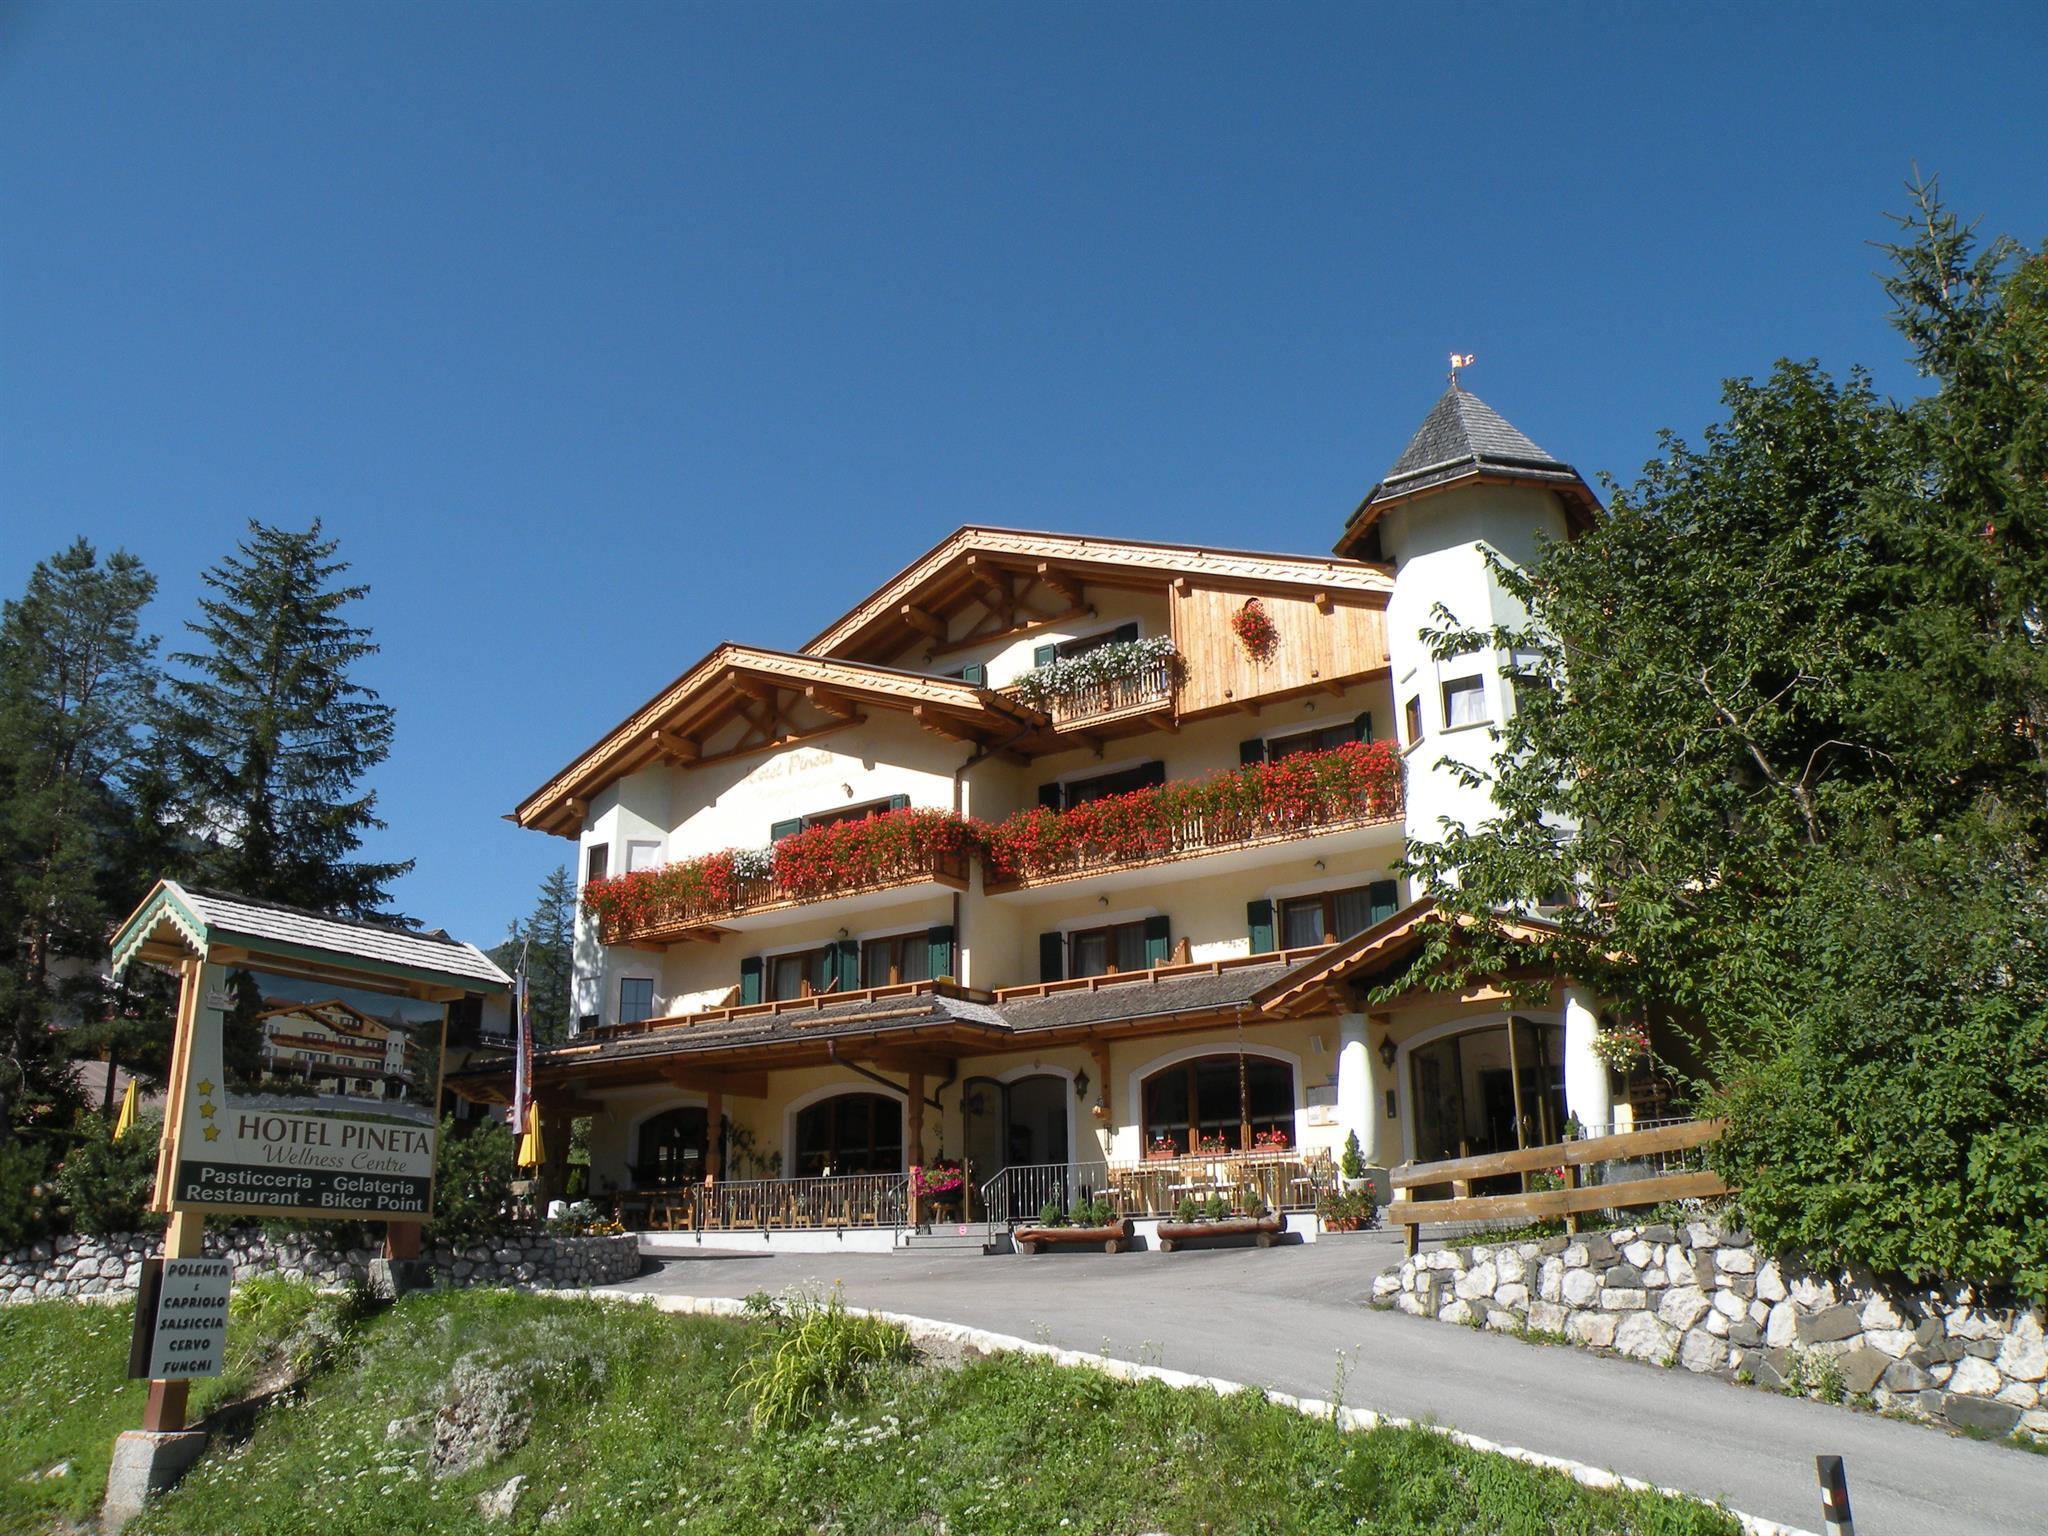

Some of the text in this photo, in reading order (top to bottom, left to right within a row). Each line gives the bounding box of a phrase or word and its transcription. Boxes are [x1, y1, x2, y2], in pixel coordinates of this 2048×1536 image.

[238, 1115, 430, 1154] HOTEL PINETA
[262, 1143, 407, 1172] Wellness Centre
[201, 1167, 312, 1189] Pasticceria
[333, 1176, 414, 1195] Gelateria
[186, 1184, 300, 1205] Restaurant
[321, 1192, 372, 1208] Biker
[377, 1195, 423, 1211] Point
[168, 1264, 229, 1277] POLENTA
[164, 1297, 226, 1309] CAPRIOLO
[160, 1318, 224, 1330] SALSICCIA
[169, 1339, 211, 1352] CERVO
[162, 1360, 212, 1373] FUNGHI
